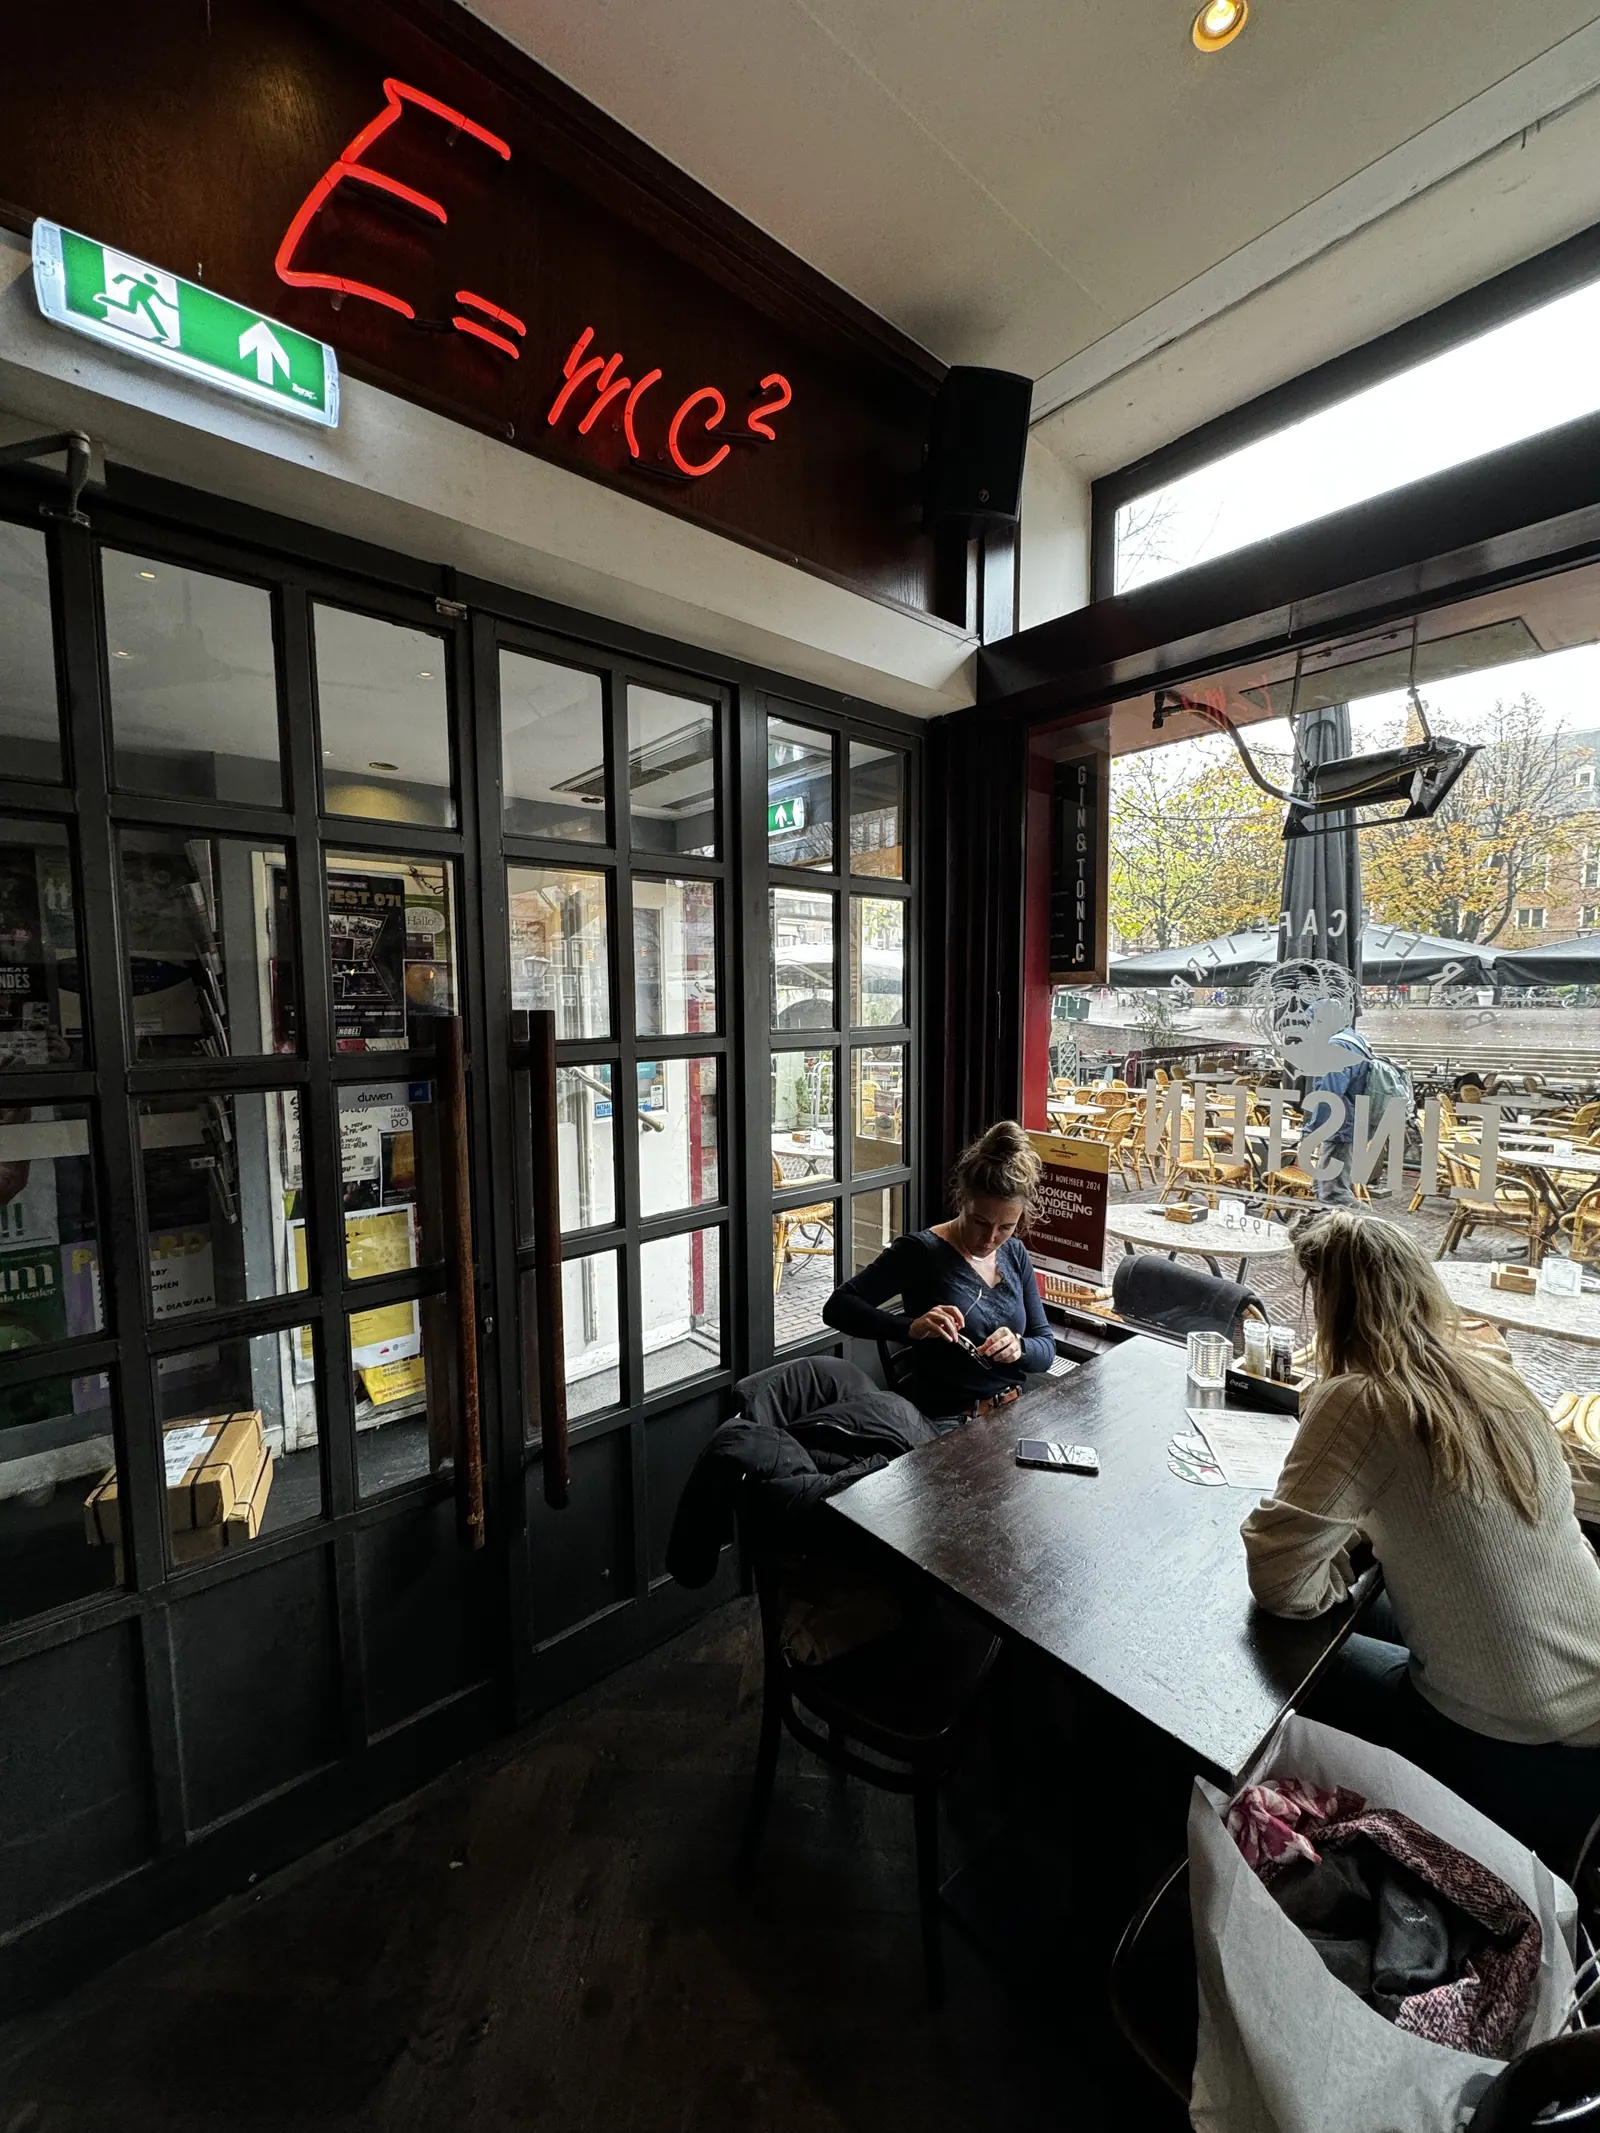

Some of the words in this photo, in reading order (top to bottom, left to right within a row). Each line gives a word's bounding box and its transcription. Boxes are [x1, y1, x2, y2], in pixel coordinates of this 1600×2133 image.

[358, 1092, 393, 1102] duwen
[391, 1118, 409, 1128] DO
[1049, 1172, 1054, 1181] 3
[1056, 1174, 1084, 1188] NOVEMBER
[1086, 1181, 1101, 1191] 2024
[1038, 1185, 1082, 1204] BOKKEN
[1043, 1206, 1073, 1220] LEIDEN
[166, 1296, 213, 1311] DIAWARA
